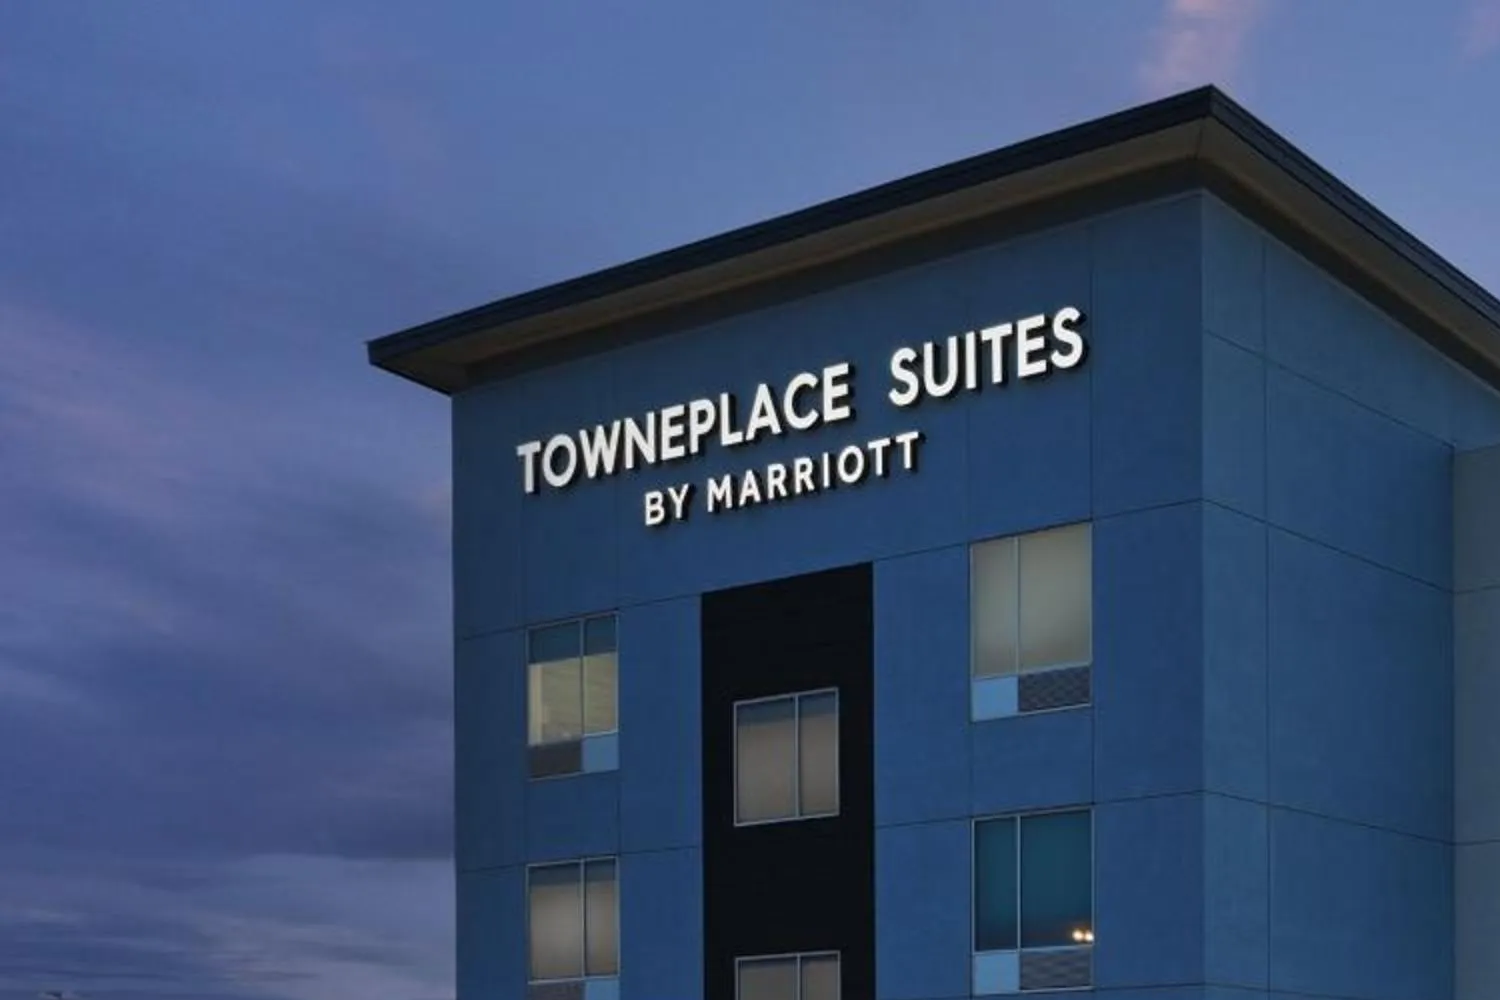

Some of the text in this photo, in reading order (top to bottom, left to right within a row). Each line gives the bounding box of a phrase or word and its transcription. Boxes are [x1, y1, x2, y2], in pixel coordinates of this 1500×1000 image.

[517, 306, 1084, 493] TOWNEPLACE SUITES
[645, 431, 919, 526] BY MARRIOTT
